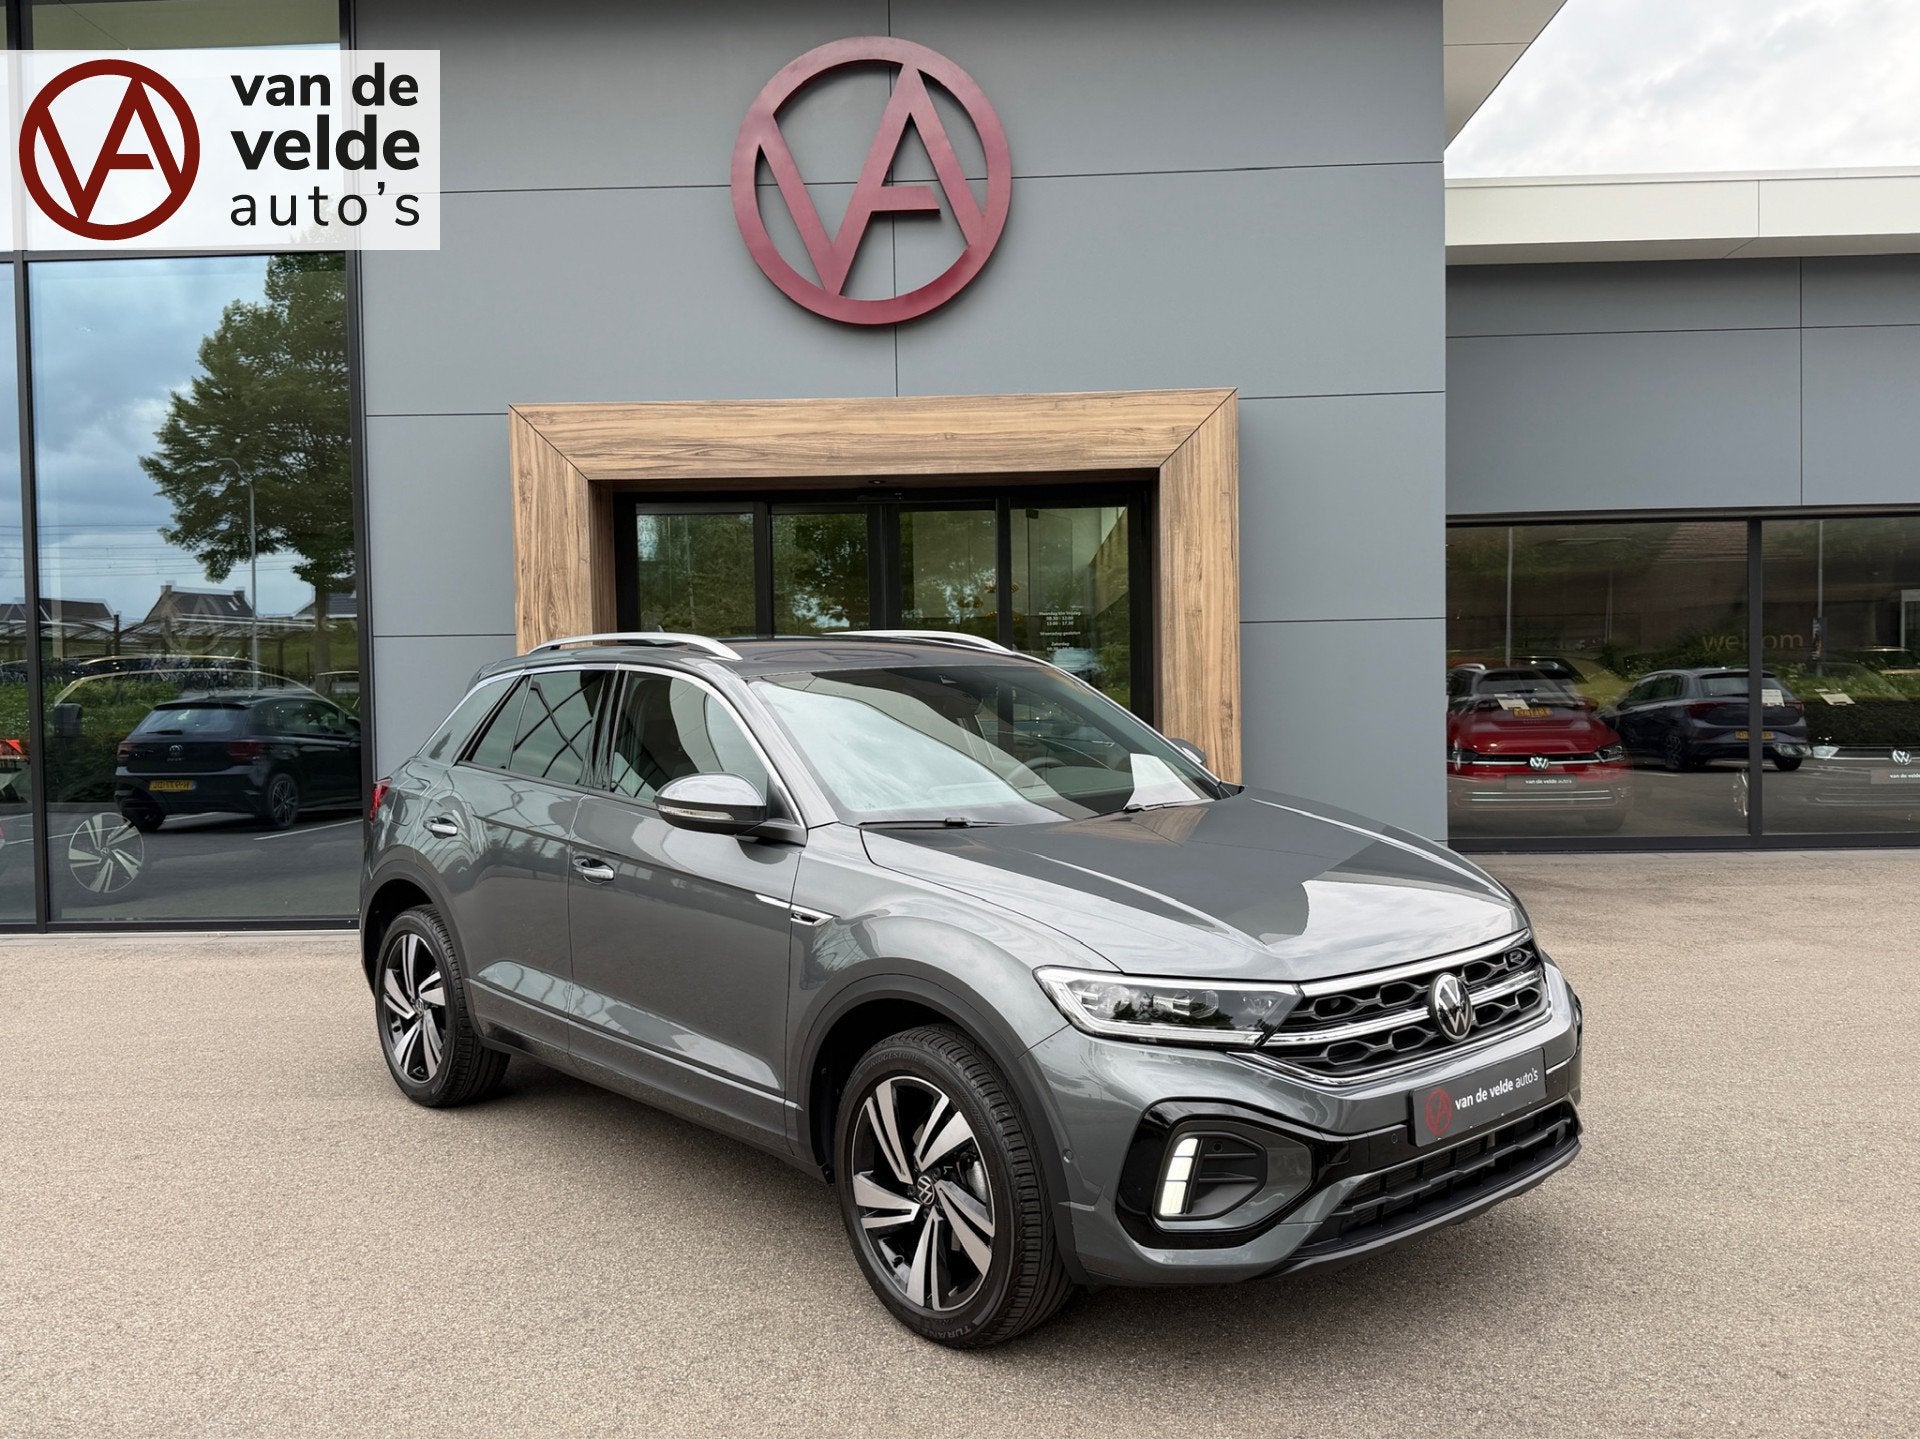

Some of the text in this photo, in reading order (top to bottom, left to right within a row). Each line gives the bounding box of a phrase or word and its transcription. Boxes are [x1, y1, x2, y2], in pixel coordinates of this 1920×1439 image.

[1702, 628, 1803, 651] welom
[1455, 1095, 1474, 1110] van
[1476, 1088, 1488, 1103] de
[1489, 1078, 1513, 1098] velde
[1515, 1067, 1539, 1088] auto's
